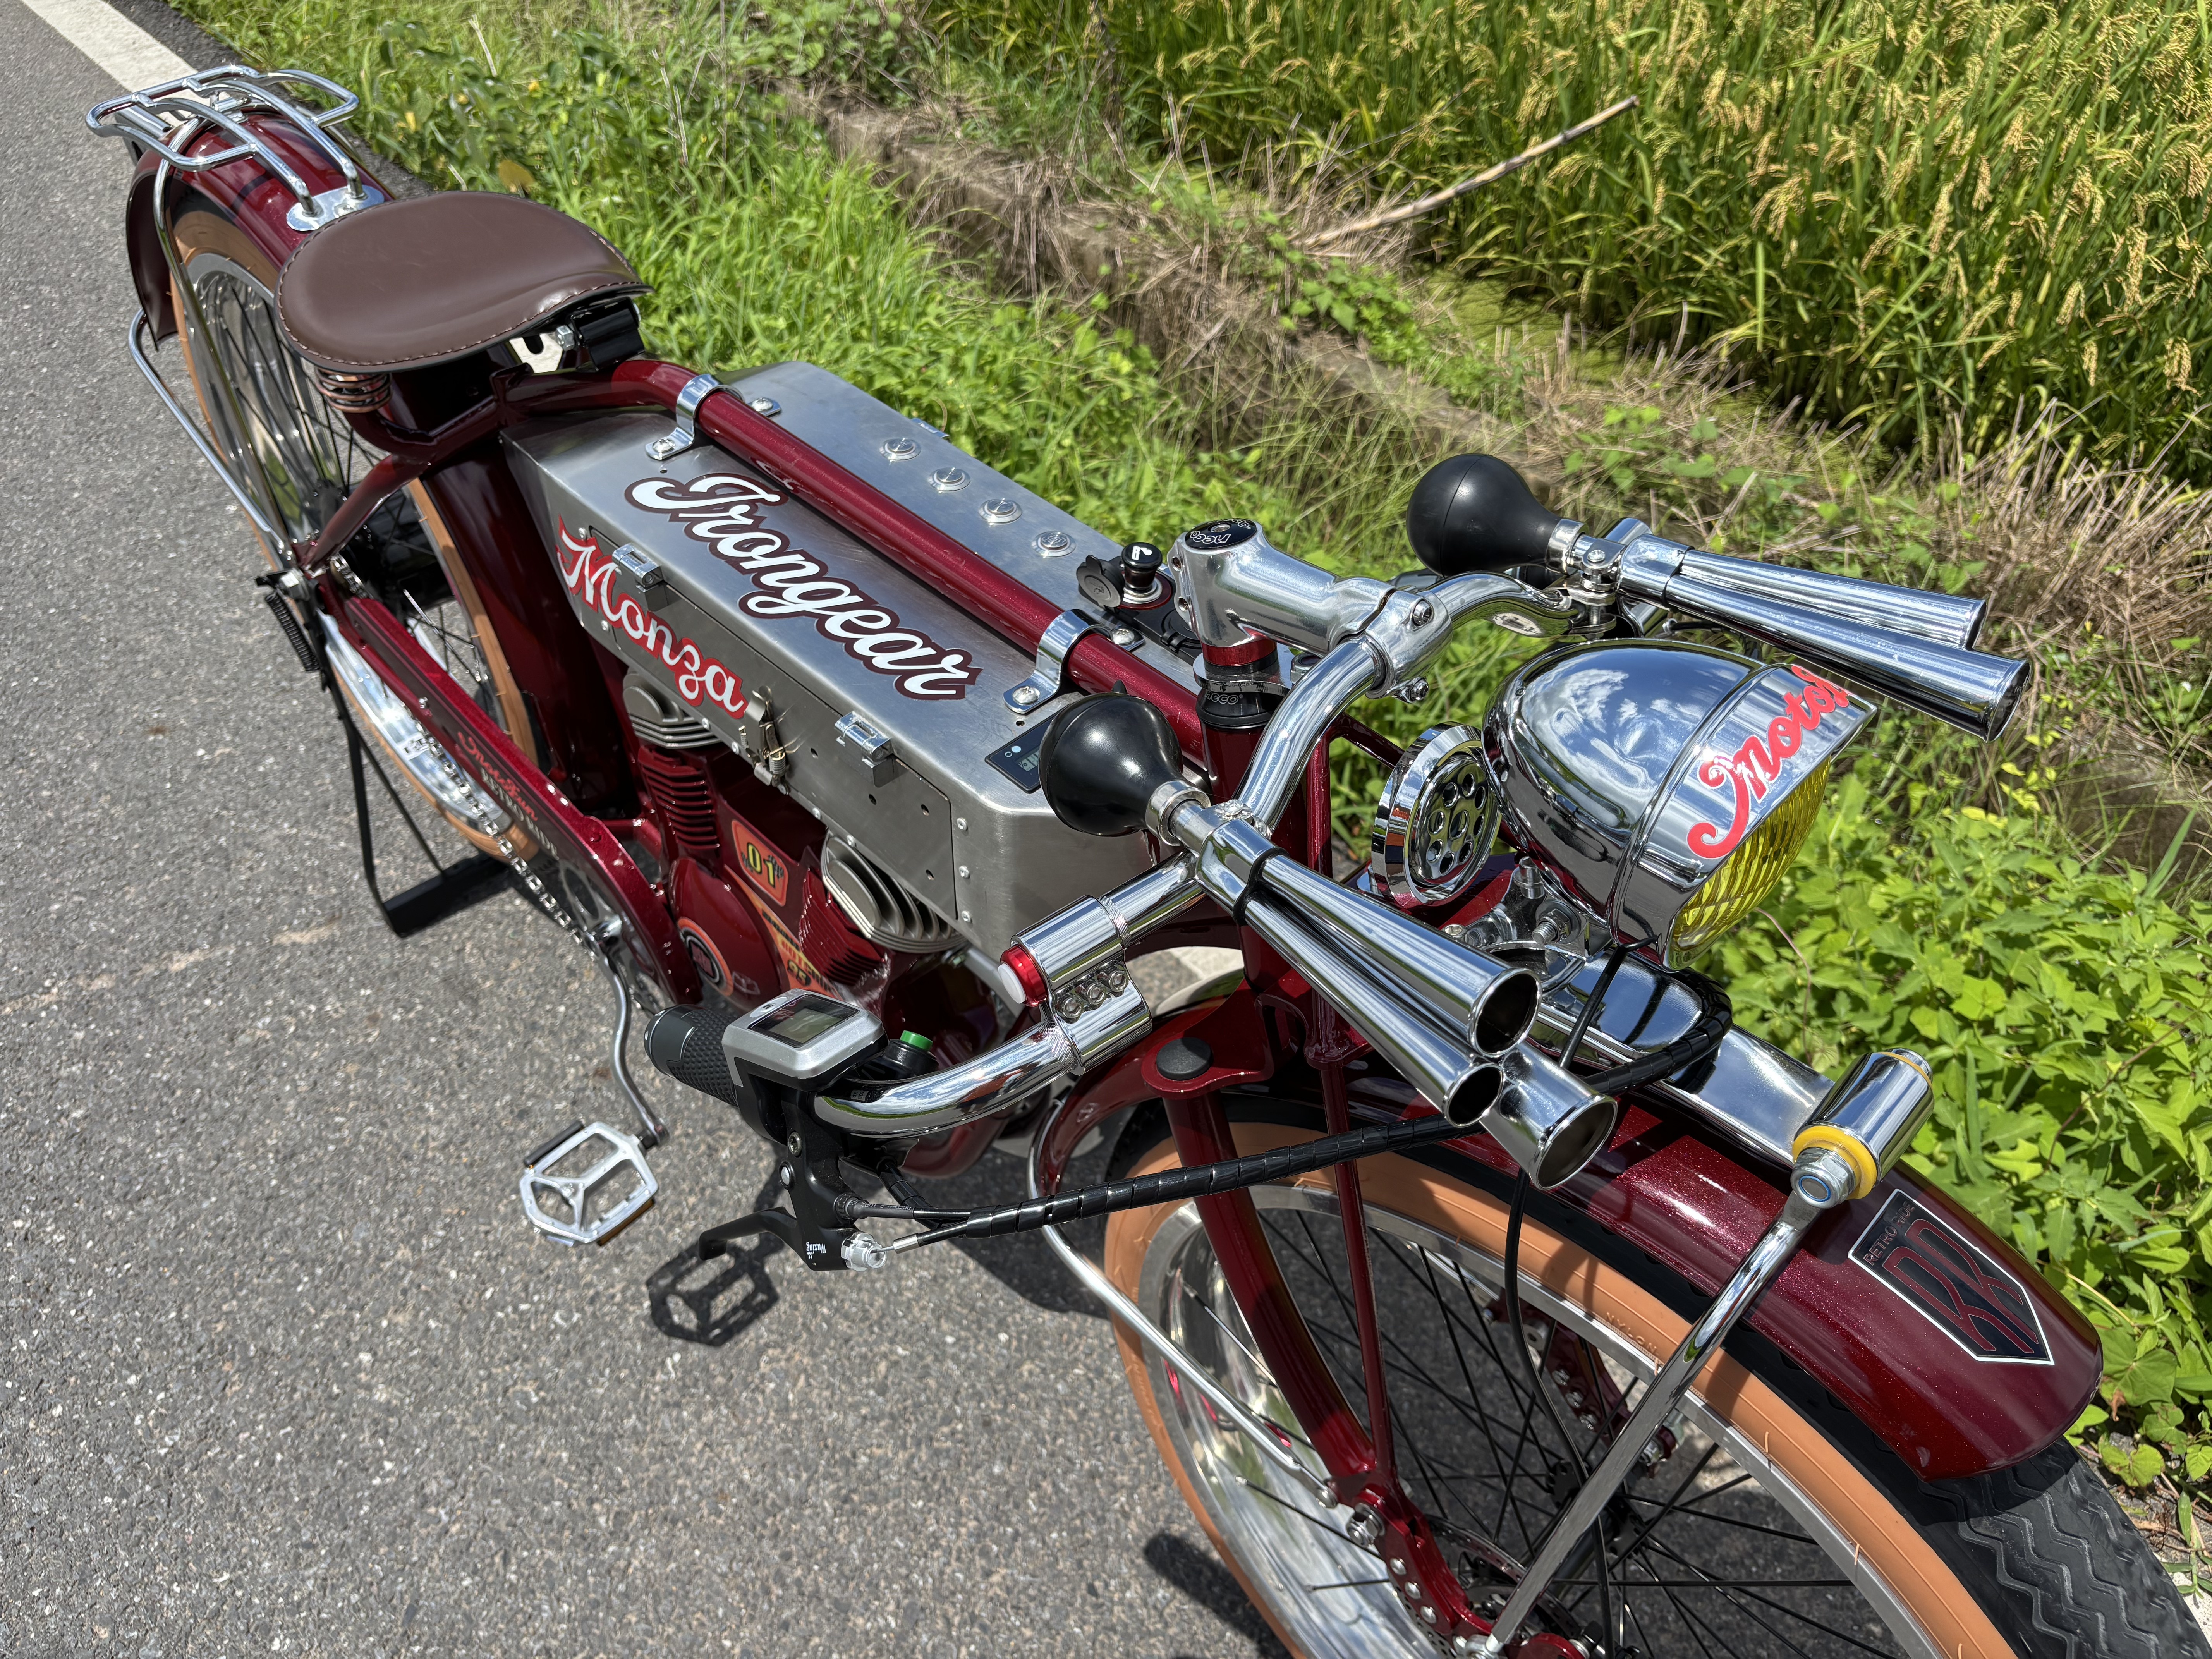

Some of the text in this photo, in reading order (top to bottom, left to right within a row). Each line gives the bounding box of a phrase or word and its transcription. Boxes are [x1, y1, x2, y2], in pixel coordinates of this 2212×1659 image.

[1190, 531, 1231, 544] neco
[627, 474, 981, 699] Irongear
[556, 515, 747, 717] Monza
[747, 842, 775, 888] 01
[806, 1242, 826, 1254] Wuxing
[1863, 1201, 1915, 1266] RETRO RIDE
[1606, 1312, 1659, 1355] NYLON
